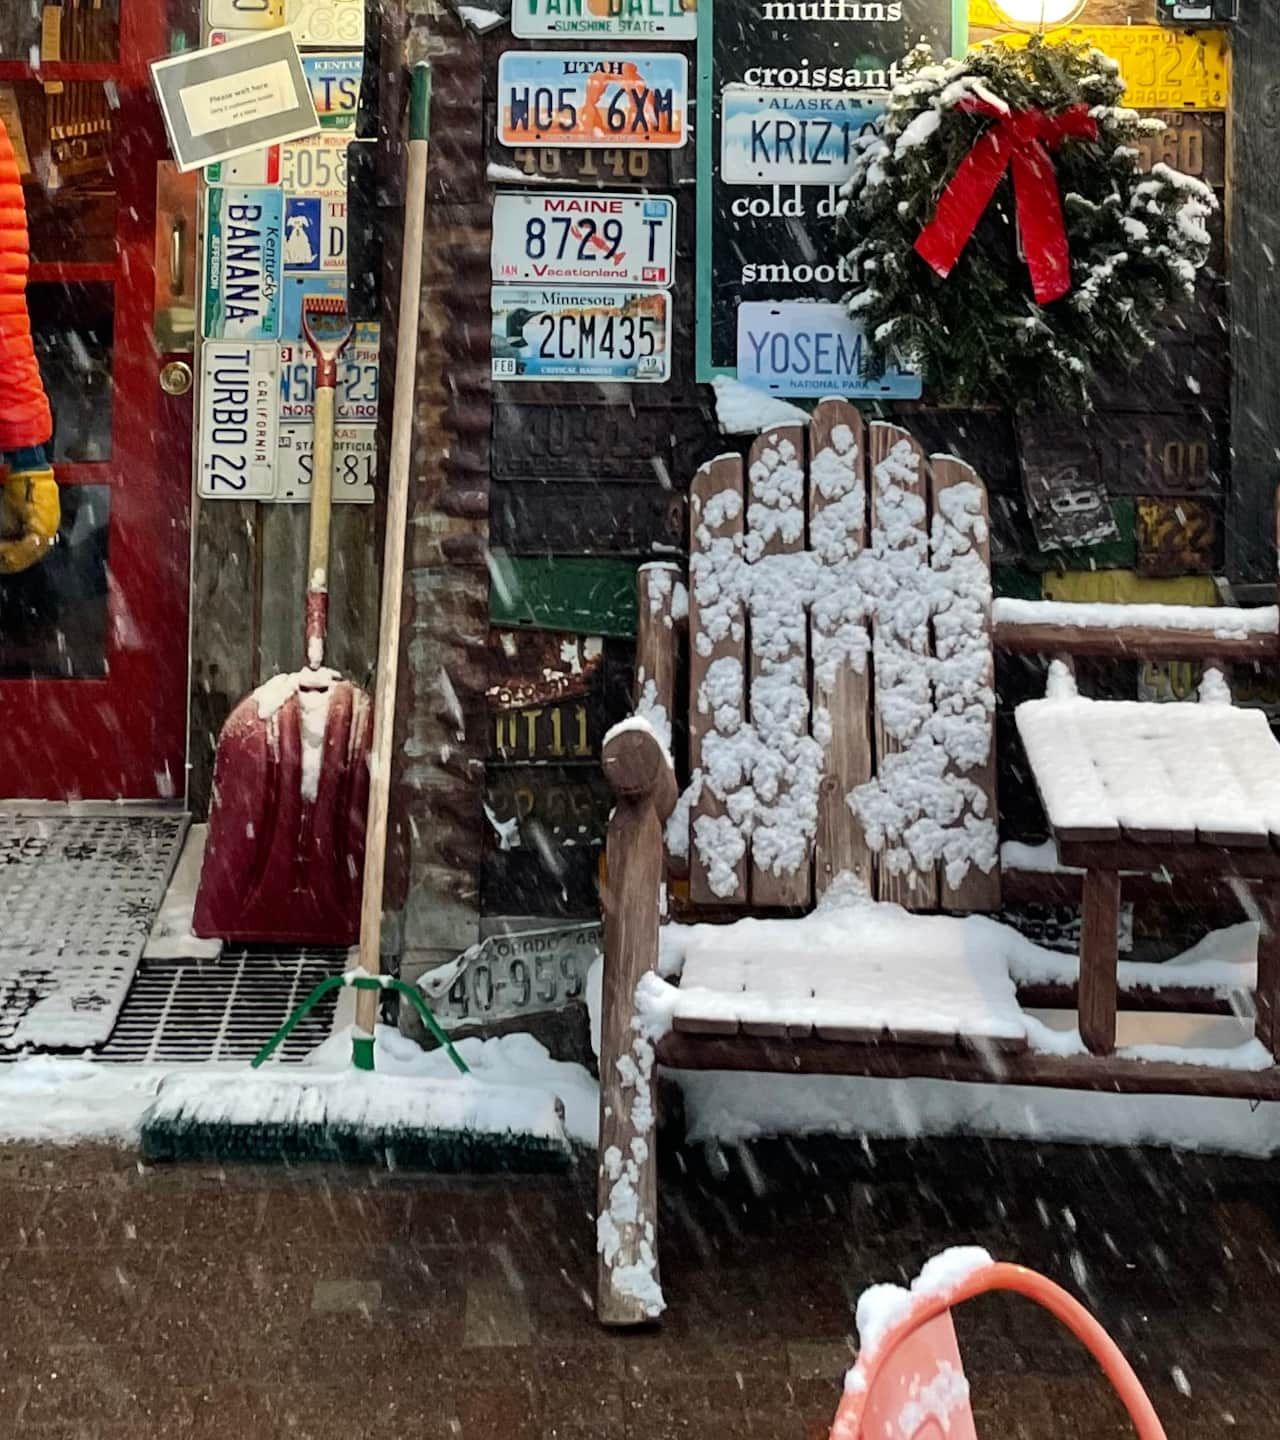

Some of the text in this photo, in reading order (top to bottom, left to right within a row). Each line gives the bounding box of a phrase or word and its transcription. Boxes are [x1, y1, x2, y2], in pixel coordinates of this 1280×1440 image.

[554, 19, 656, 34] SUNSHINE STATE
[562, 60, 625, 76] UTAH
[769, 97, 847, 112] ALASKA
[543, 198, 624, 214] MAINE
[731, 184, 806, 218] cold
[524, 216, 625, 262] 8729
[225, 204, 262, 322] BANANA
[260, 227, 280, 302] Kentucky
[531, 263, 629, 279] Vacationland
[540, 290, 616, 308] Minnesota
[538, 314, 657, 360] 2CM435
[493, 359, 515, 373] FEB
[789, 378, 840, 390] NATIONAL
[210, 349, 250, 493] TURBO 22
[253, 379, 267, 462] CALIFORNIA
